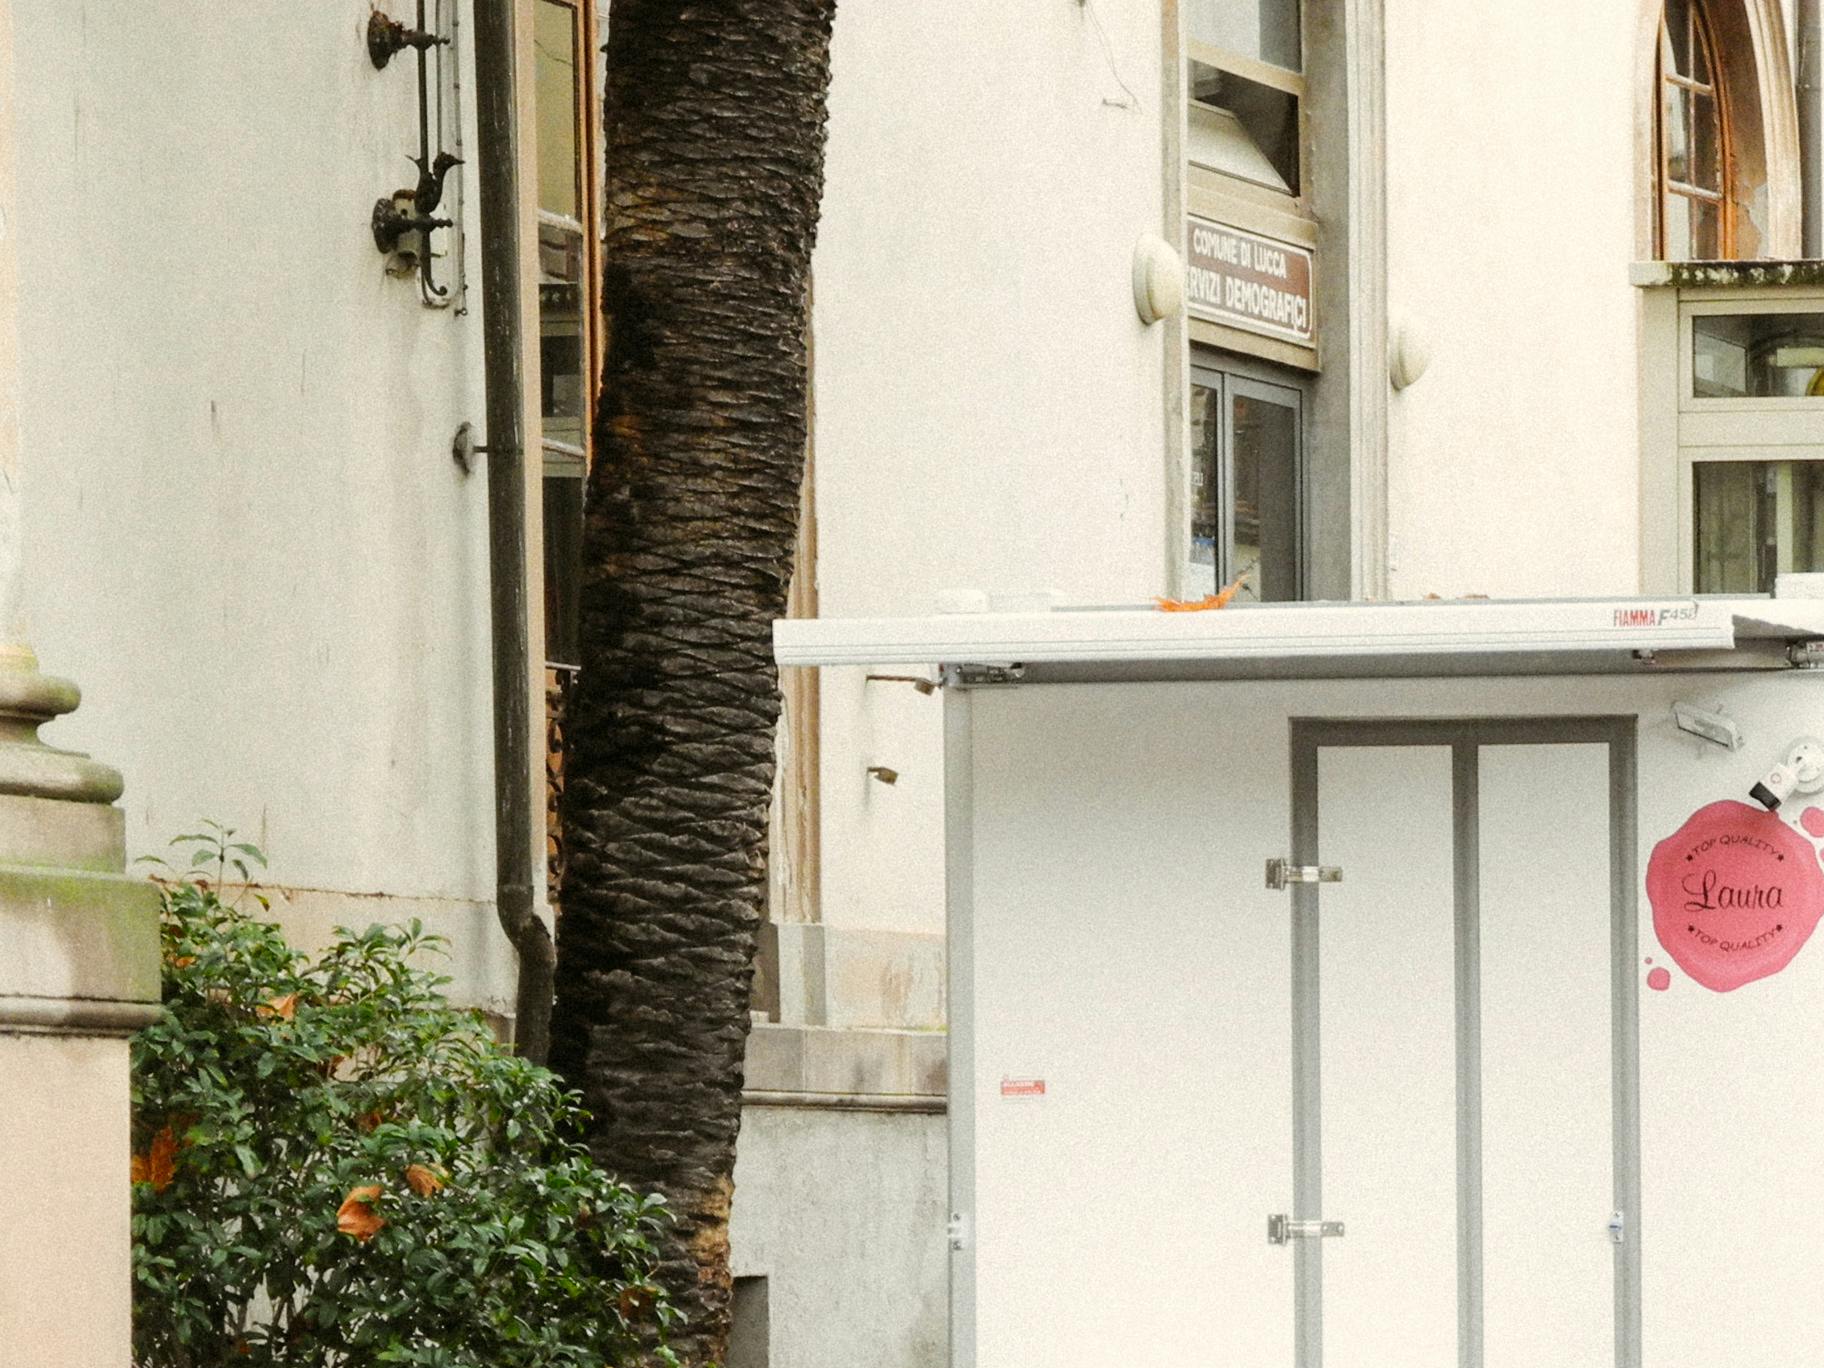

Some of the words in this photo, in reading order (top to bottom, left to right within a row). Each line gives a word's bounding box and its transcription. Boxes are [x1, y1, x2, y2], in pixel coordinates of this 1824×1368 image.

[1193, 228, 1237, 265] COMUNE
[1240, 241, 1251, 269] DI
[1253, 244, 1287, 279] LUCCA
[1187, 267, 1221, 303] RVIZI
[1226, 278, 1306, 329] DEMOGRAFICI
[1614, 609, 1656, 627] FIAMMA
[1692, 837, 1717, 857] TOP
[1719, 834, 1778, 857] QUALITY
[1681, 869, 1783, 912] Laura
[1695, 929, 1718, 947] TOP
[1719, 928, 1777, 952] QUALITY
